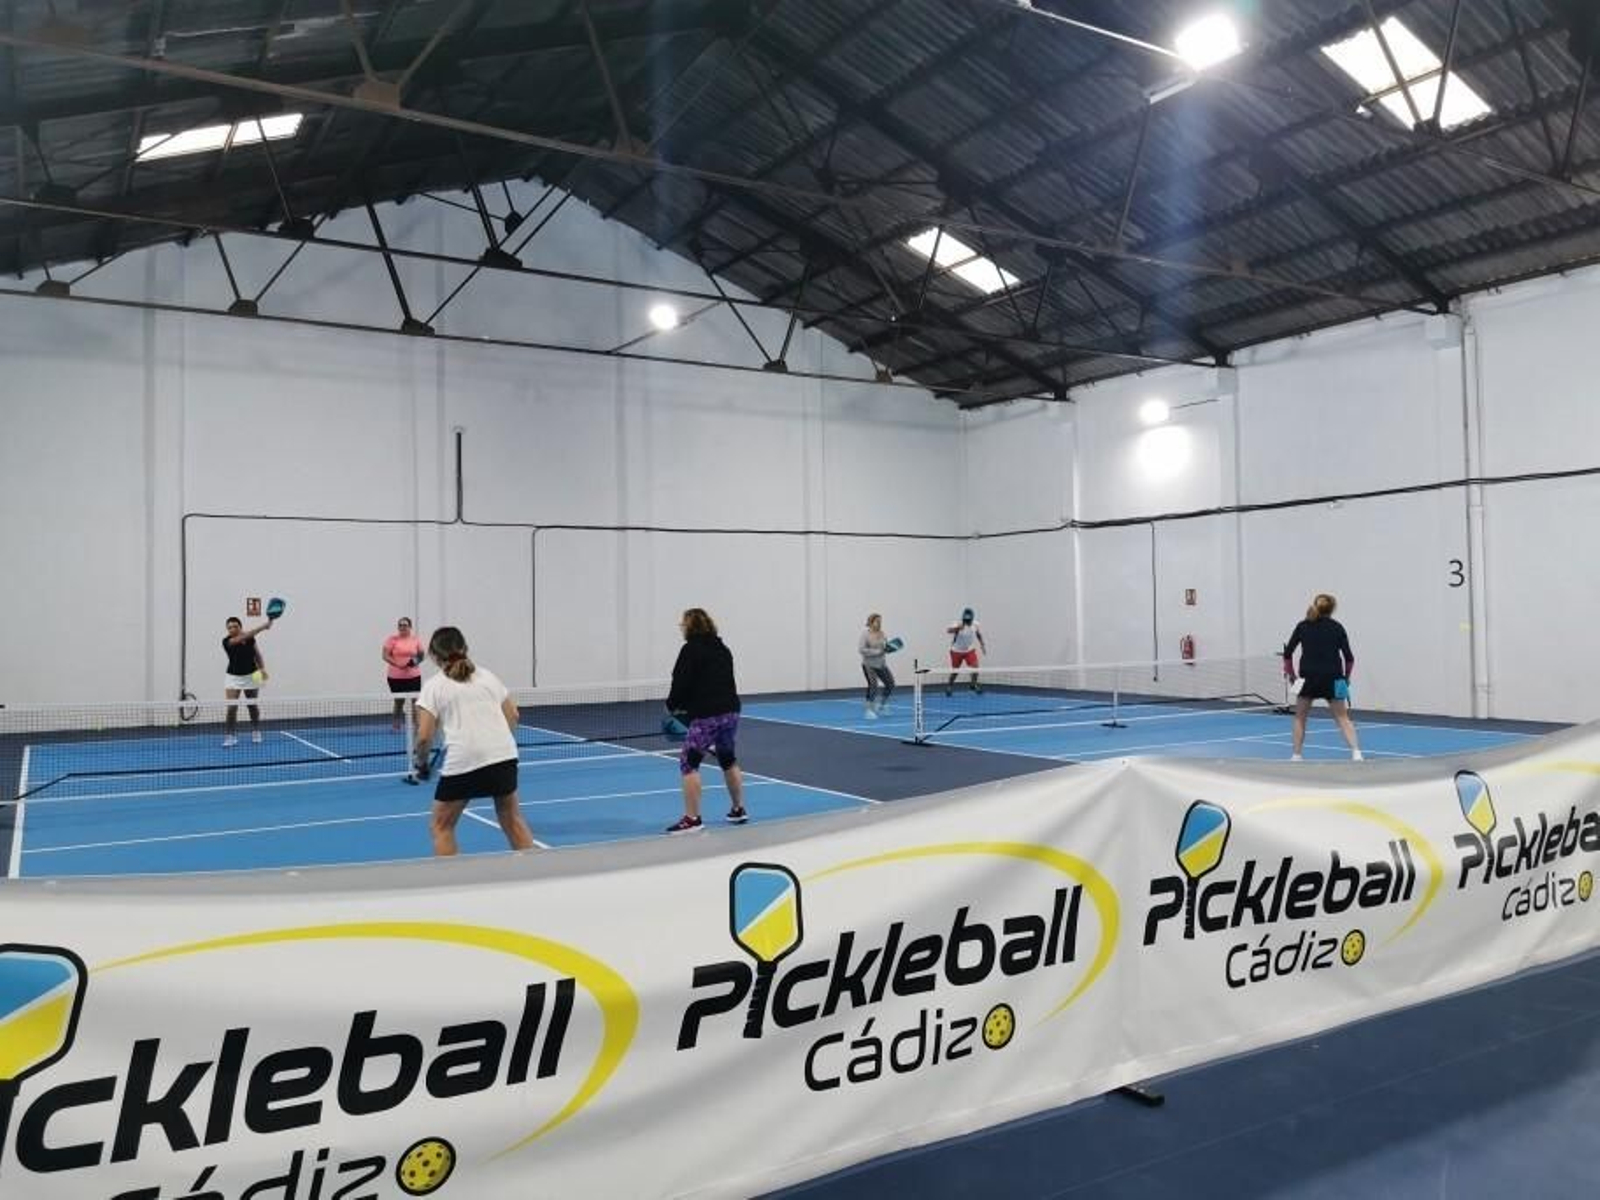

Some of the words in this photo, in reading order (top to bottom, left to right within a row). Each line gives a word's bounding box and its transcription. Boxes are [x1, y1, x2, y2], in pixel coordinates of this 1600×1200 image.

[1449, 559, 1465, 588] 3
[1143, 838, 1416, 946] Pickleball
[677, 884, 1083, 1051] Pickleball
[1226, 930, 1339, 989] Cádiz
[804, 1009, 978, 1092] Cádiz
